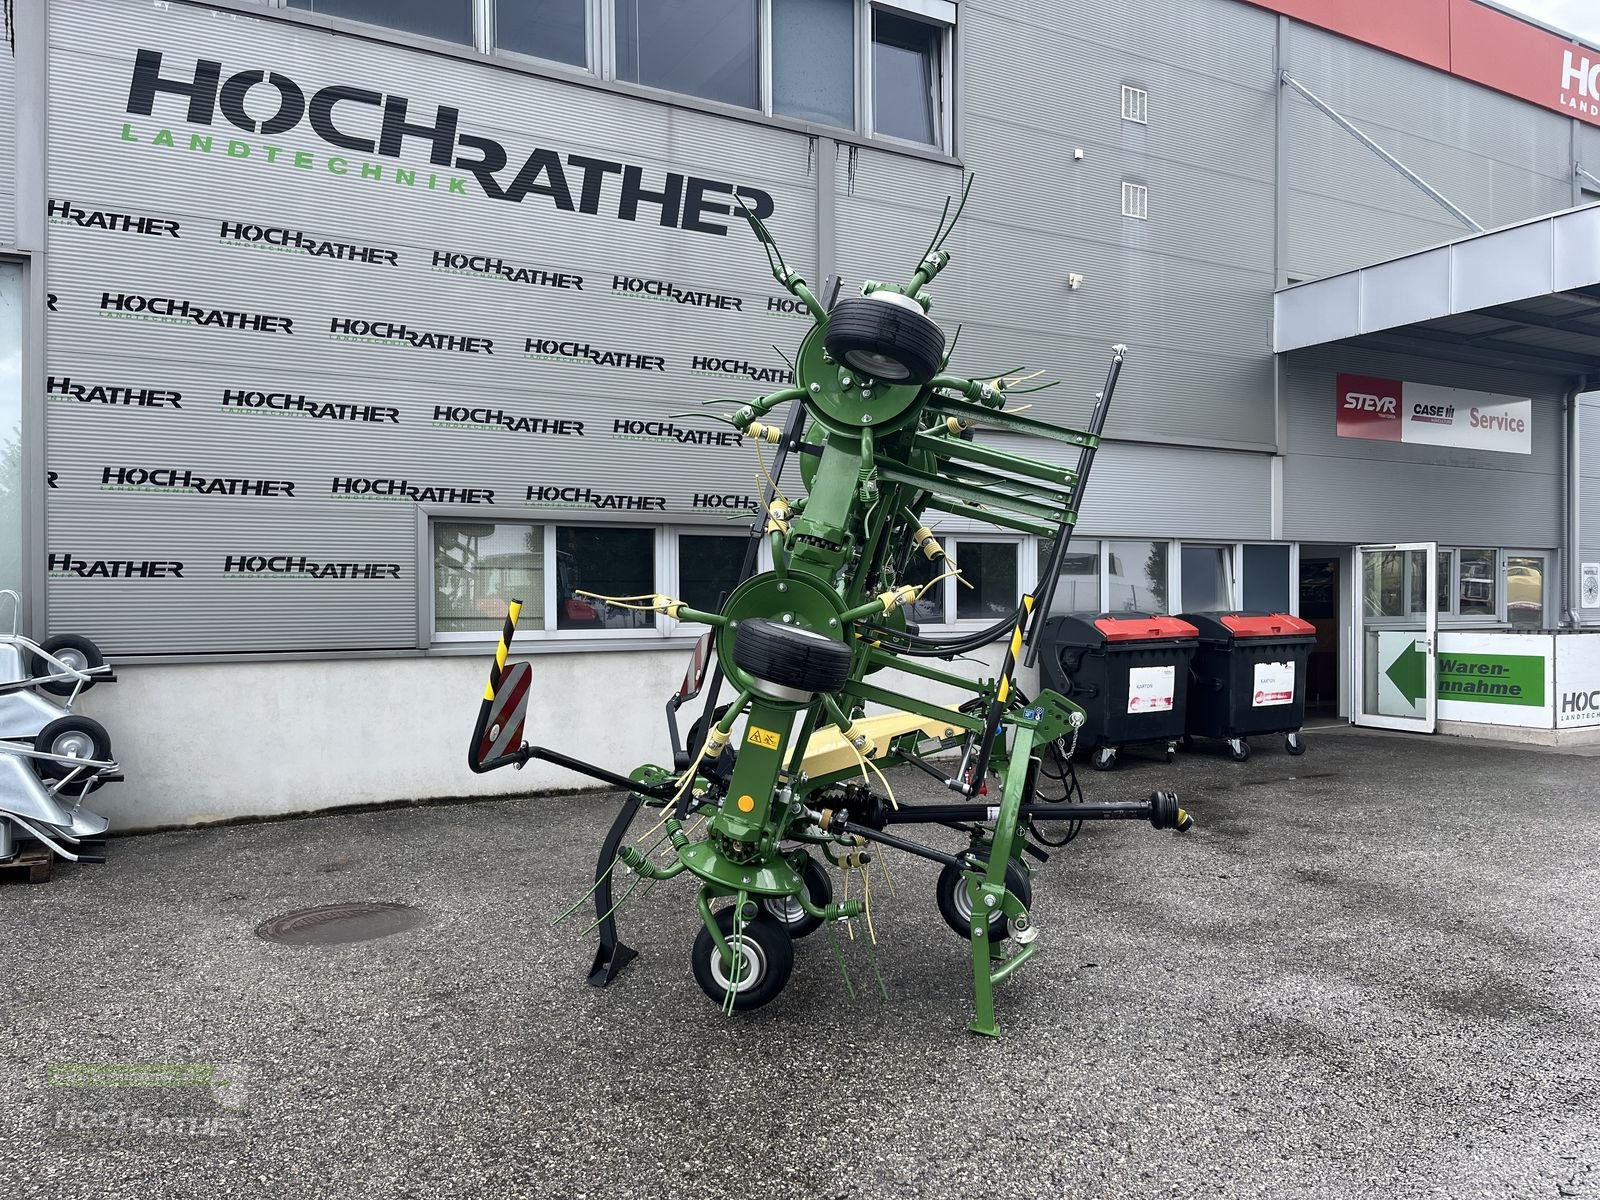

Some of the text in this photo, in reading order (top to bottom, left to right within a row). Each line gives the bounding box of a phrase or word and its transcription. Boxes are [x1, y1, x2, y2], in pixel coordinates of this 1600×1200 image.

[1560, 93, 1599, 116] LAND
[121, 124, 468, 195] LANDTECHNIK
[126, 49, 774, 242] HOCHRATHER
[220, 221, 398, 267] HOCHRATHER
[432, 251, 583, 291] HOCHRATHER
[612, 275, 742, 312] HOCHRATHER
[100, 292, 294, 334] HOCHRATHER
[330, 317, 493, 354] HOCHRATHER
[525, 338, 665, 372] HOCHRATHER
[222, 389, 400, 424] HOCHRATHER
[1344, 392, 1397, 414] STEYR
[1413, 403, 1445, 417] CASE
[433, 405, 584, 437] HOCHRATHER
[613, 419, 744, 447] HOCHRATHER
[1470, 408, 1525, 432] Service
[101, 466, 296, 498] HOCHRATHER
[331, 476, 495, 504] HOCHRATHER
[526, 485, 667, 511] HOCHRATHER
[224, 555, 401, 579] HOCHRATHER
[1438, 658, 1510, 675] Waren-
[1562, 690, 1600, 713] HOC
